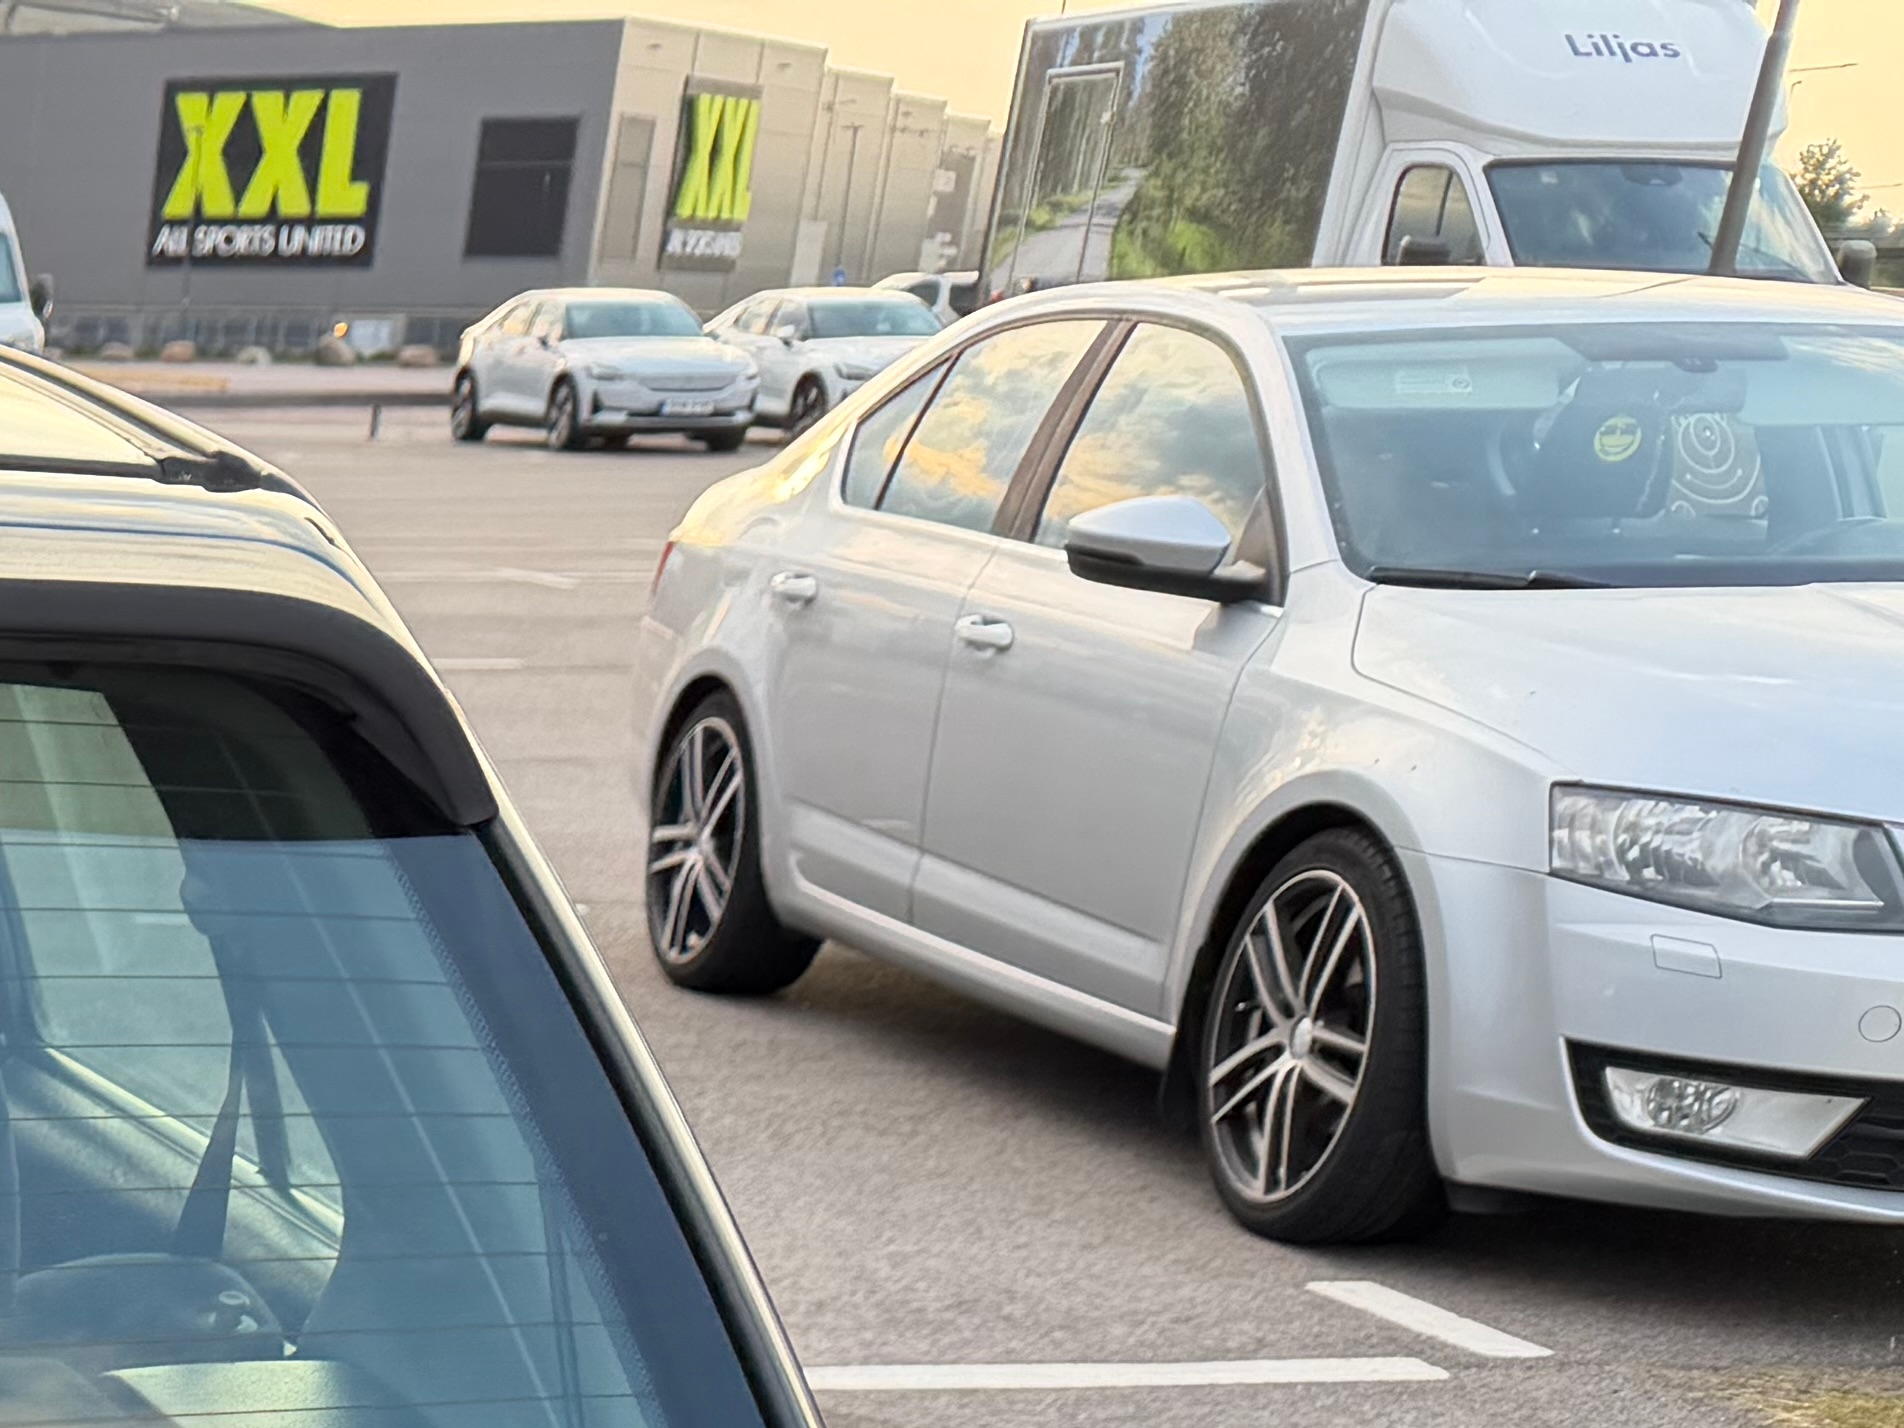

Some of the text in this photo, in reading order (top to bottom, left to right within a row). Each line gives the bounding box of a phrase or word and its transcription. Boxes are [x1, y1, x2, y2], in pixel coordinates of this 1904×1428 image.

[1564, 33, 1681, 63] Liljas
[162, 88, 370, 219] XXL
[675, 93, 760, 222] XXL
[152, 223, 366, 257] ALL SPORTS UNITED
